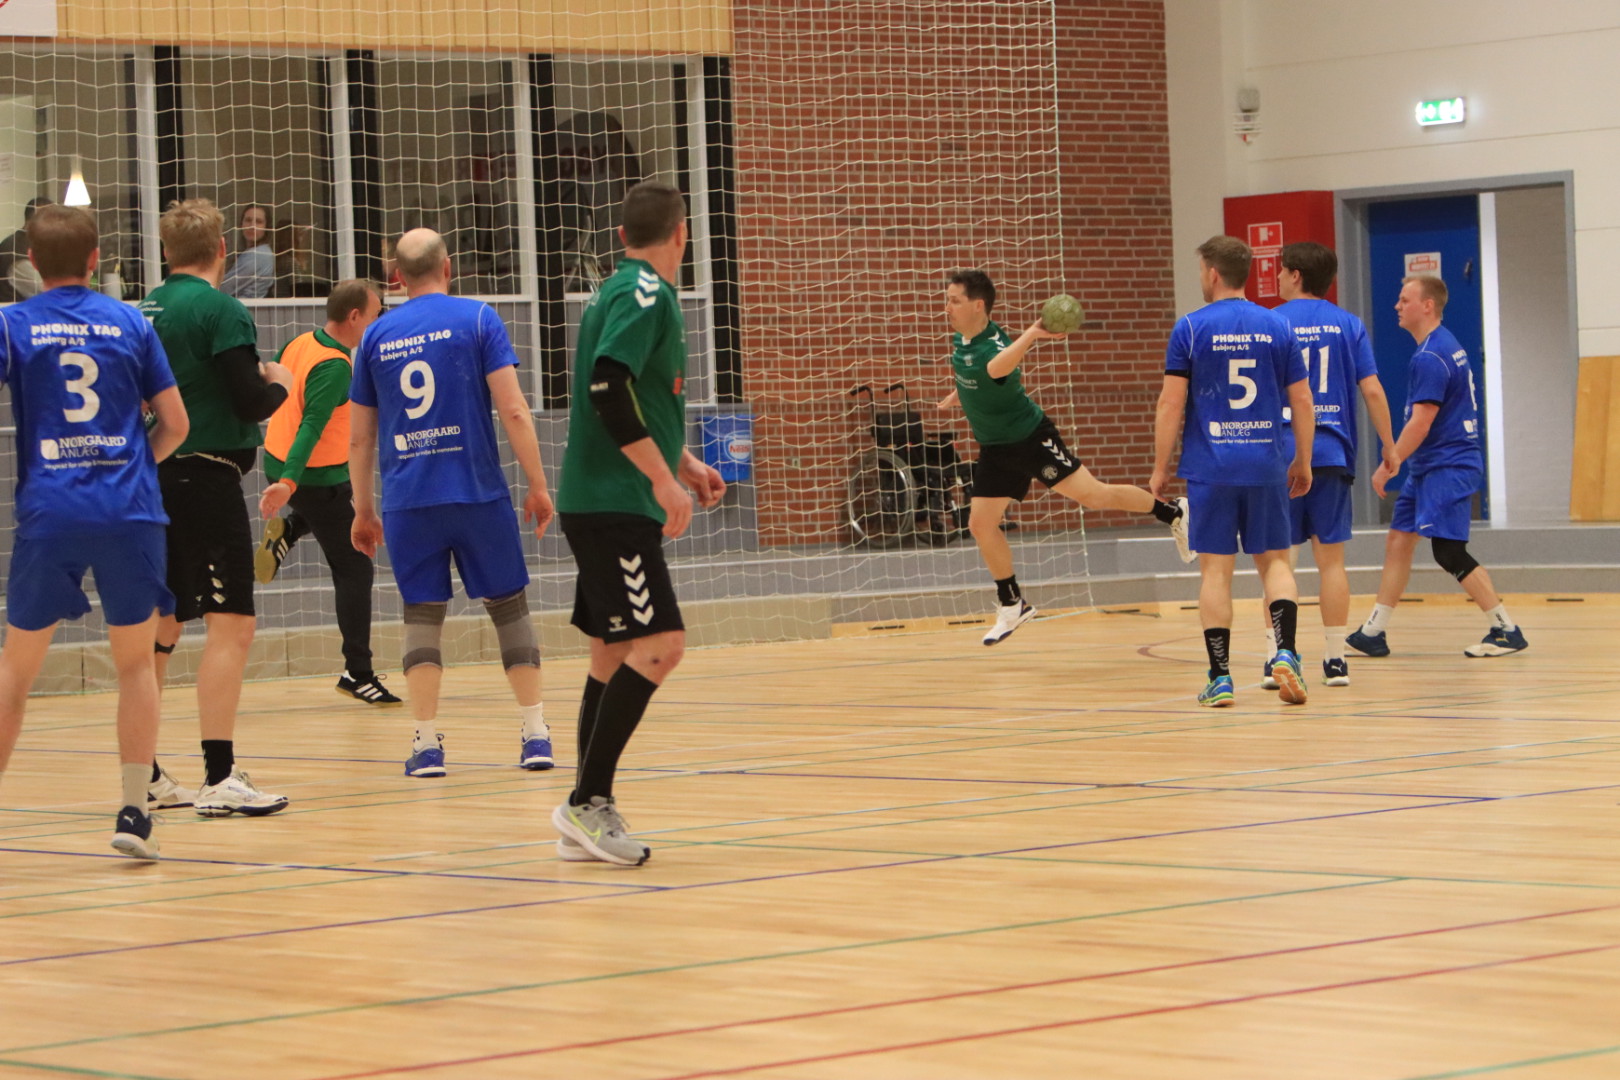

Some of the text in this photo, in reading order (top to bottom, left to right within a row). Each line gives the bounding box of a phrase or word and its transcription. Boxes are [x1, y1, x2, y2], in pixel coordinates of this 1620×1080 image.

[31, 323, 122, 337] PHØNIX TAG
[1294, 325, 1342, 335] HØNIX TAG
[31, 337, 86, 346] Esbjerg A/S
[379, 329, 452, 353] PHØNIX TAG
[1212, 334, 1252, 344] PHØNIX
[380, 346, 423, 362] Esbjerg A/S
[59, 352, 101, 423] 3
[400, 360, 435, 420] 9
[1228, 358, 1257, 410] 5
[1313, 405, 1341, 413] GAARD
[1221, 421, 1273, 429] NØRGAARD
[407, 425, 461, 441] NØRGAARD
[1222, 428, 1251, 437] ANLÆG
[59, 434, 128, 449] NØRGAARD
[407, 437, 438, 450] ANLÆG
[59, 447, 99, 459] ANLÆG
